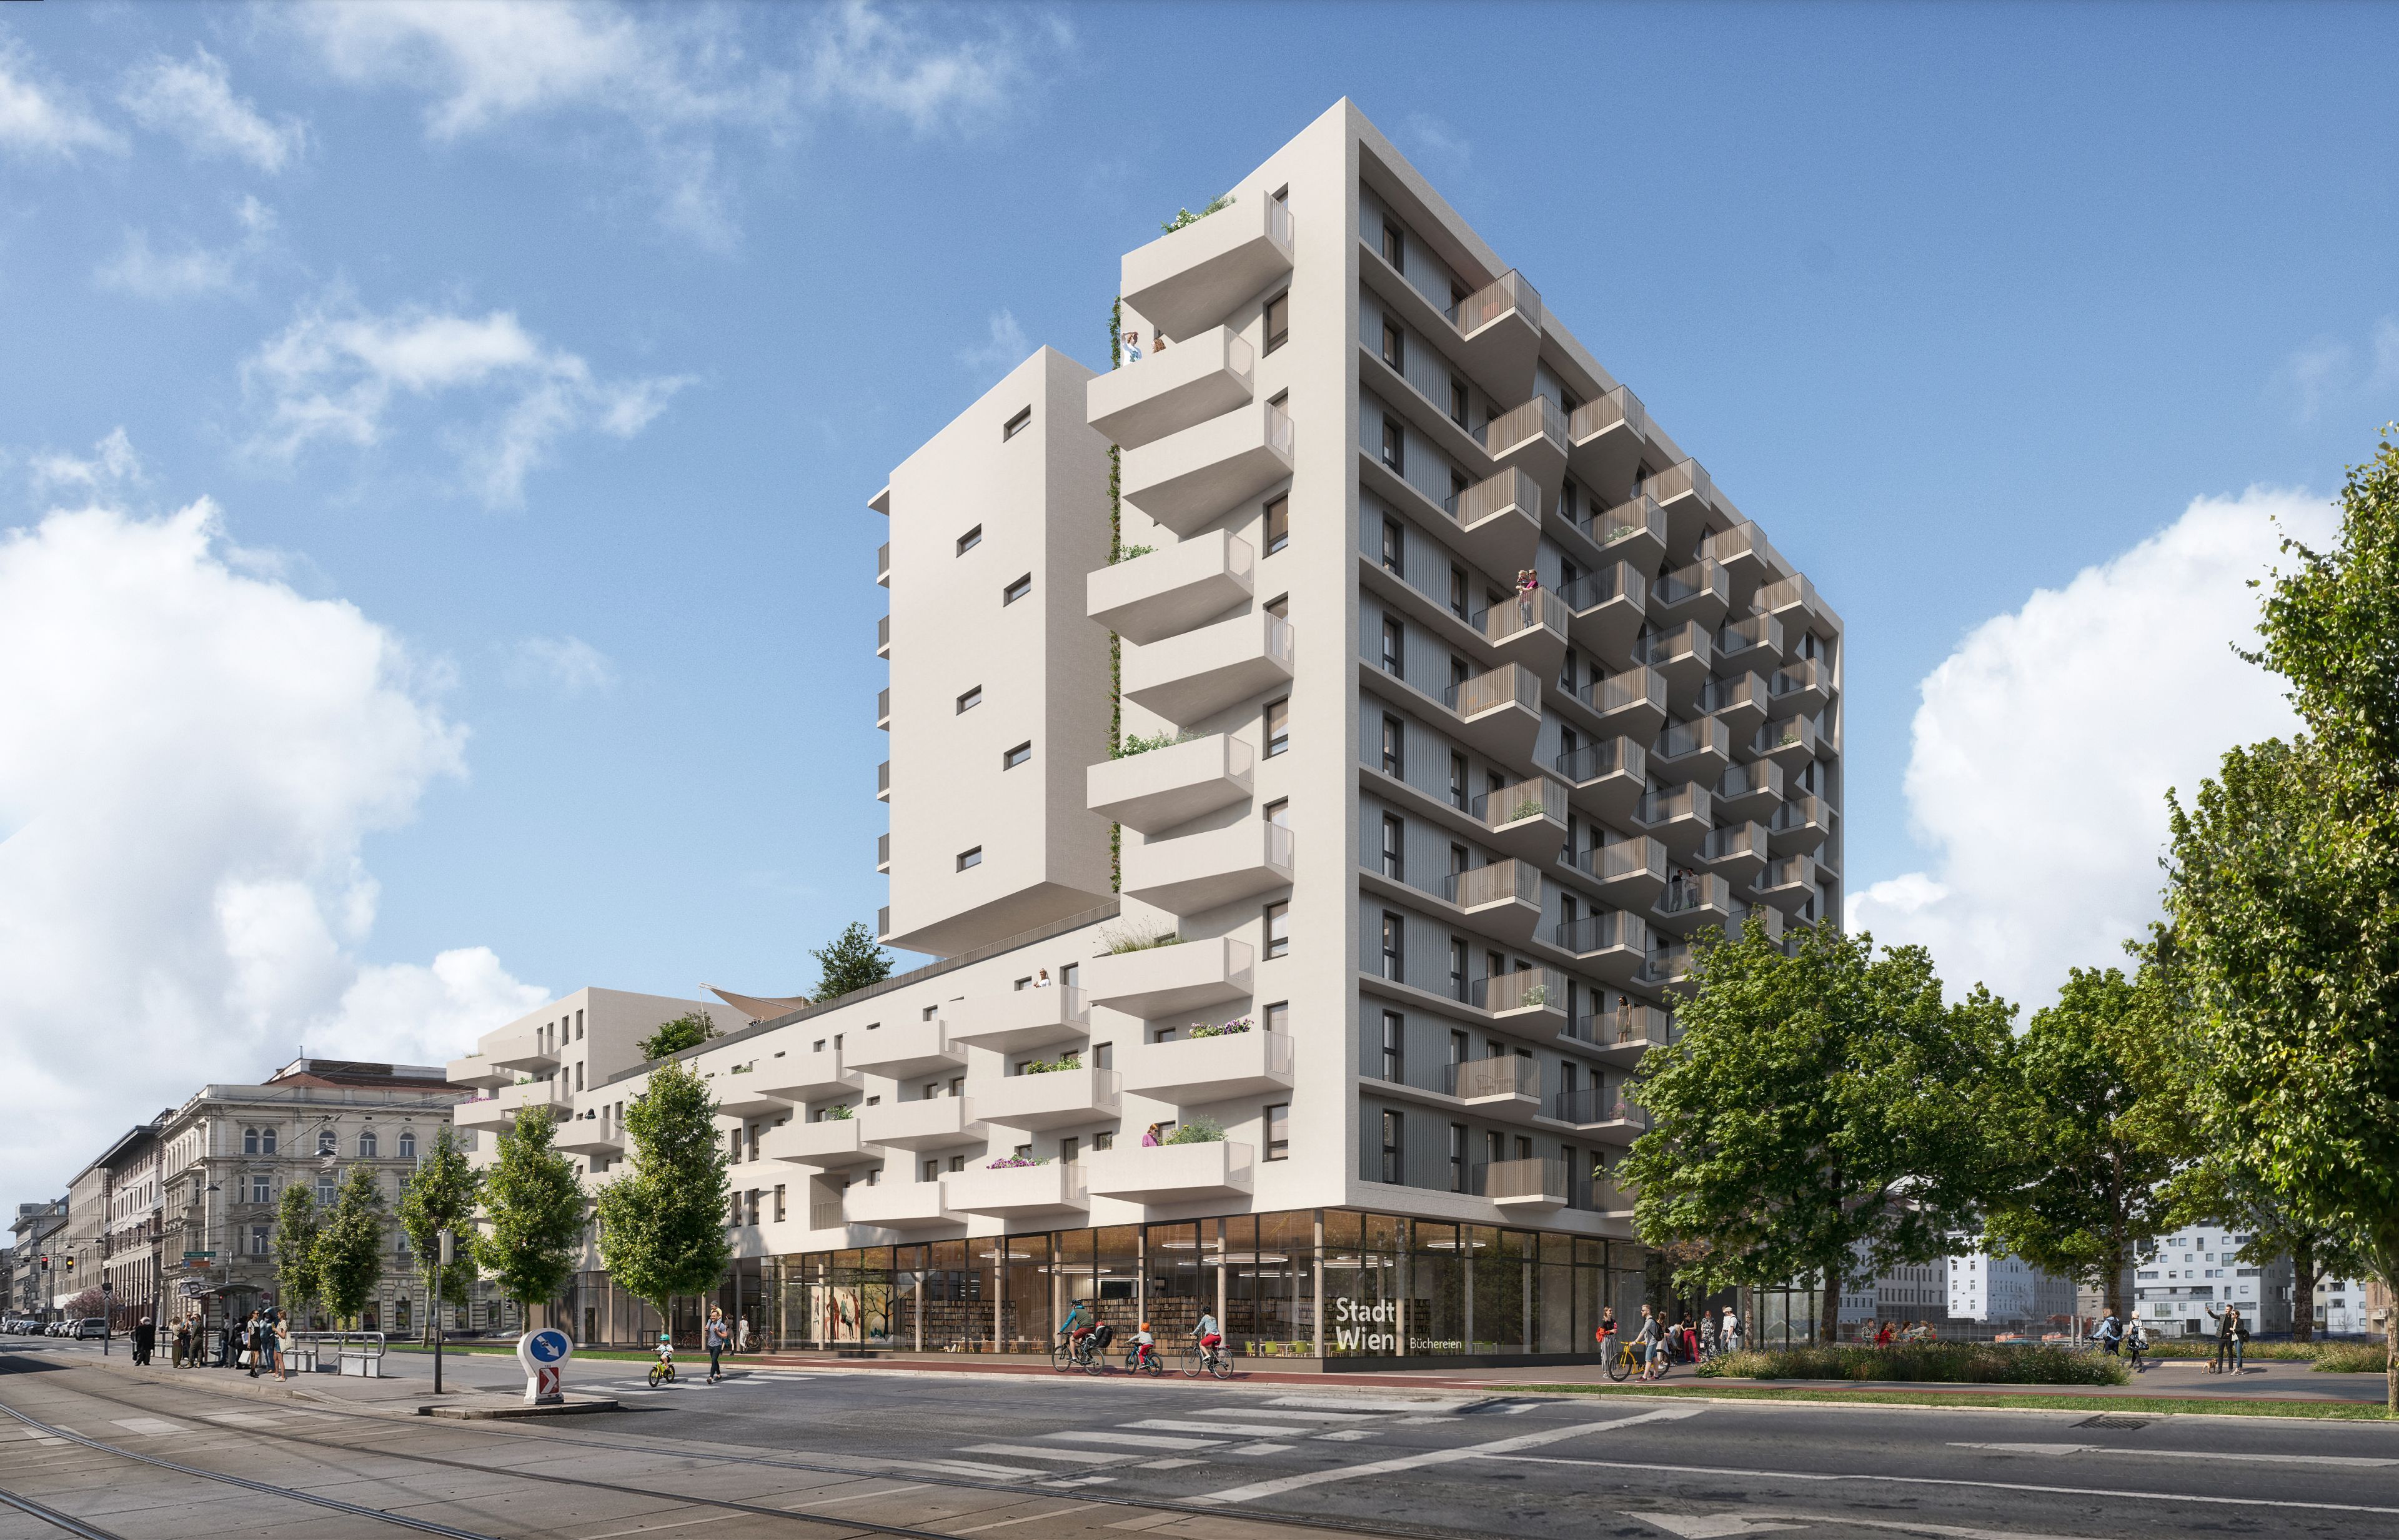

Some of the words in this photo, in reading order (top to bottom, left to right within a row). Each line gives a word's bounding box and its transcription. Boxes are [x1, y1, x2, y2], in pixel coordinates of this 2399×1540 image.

[1336, 1297, 1395, 1322] Stadt
[1336, 1326, 1394, 1350] Wien
[1410, 1338, 1462, 1349] Büchereien
